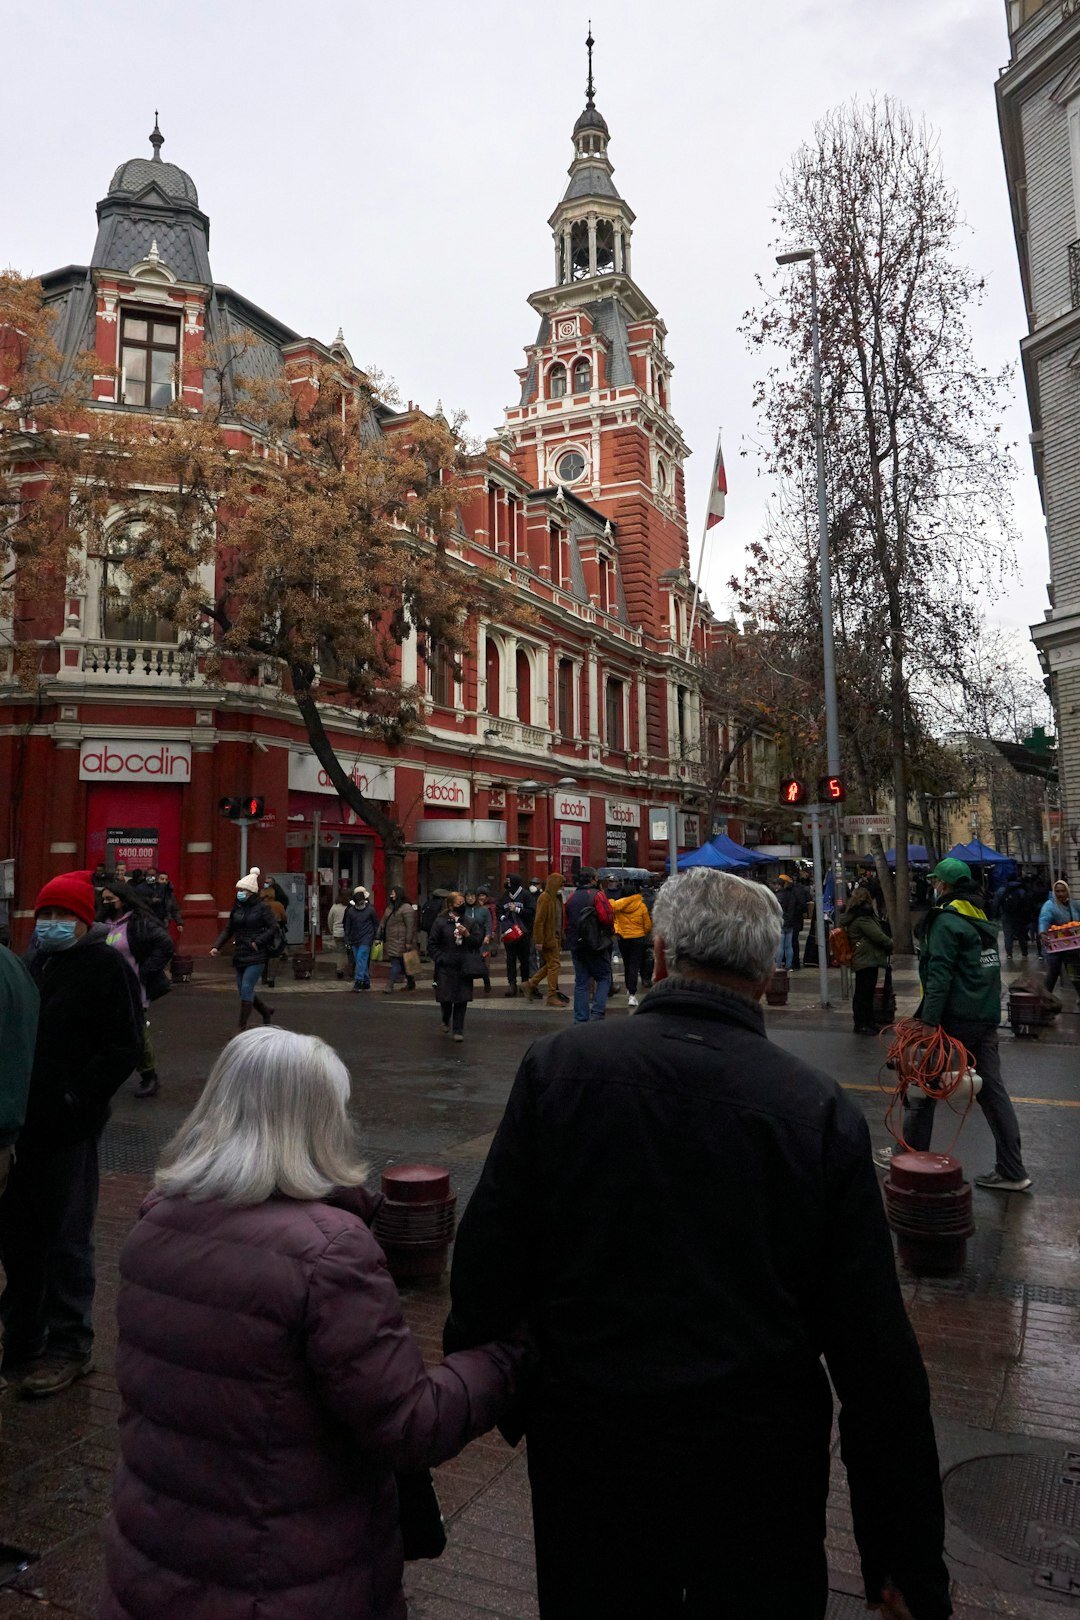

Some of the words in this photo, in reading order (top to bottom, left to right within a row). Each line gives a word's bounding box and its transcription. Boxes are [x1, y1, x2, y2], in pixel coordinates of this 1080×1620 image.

[82, 745, 189, 775] abcdin
[318, 767, 369, 792] adin
[829, 779, 841, 798] 5
[426, 779, 464, 803] abcdin
[560, 798, 586, 817] abcdin
[848, 817, 865, 825] SANTO
[866, 817, 890, 825] DOMINGO
[118, 848, 153, 858] $400.000
